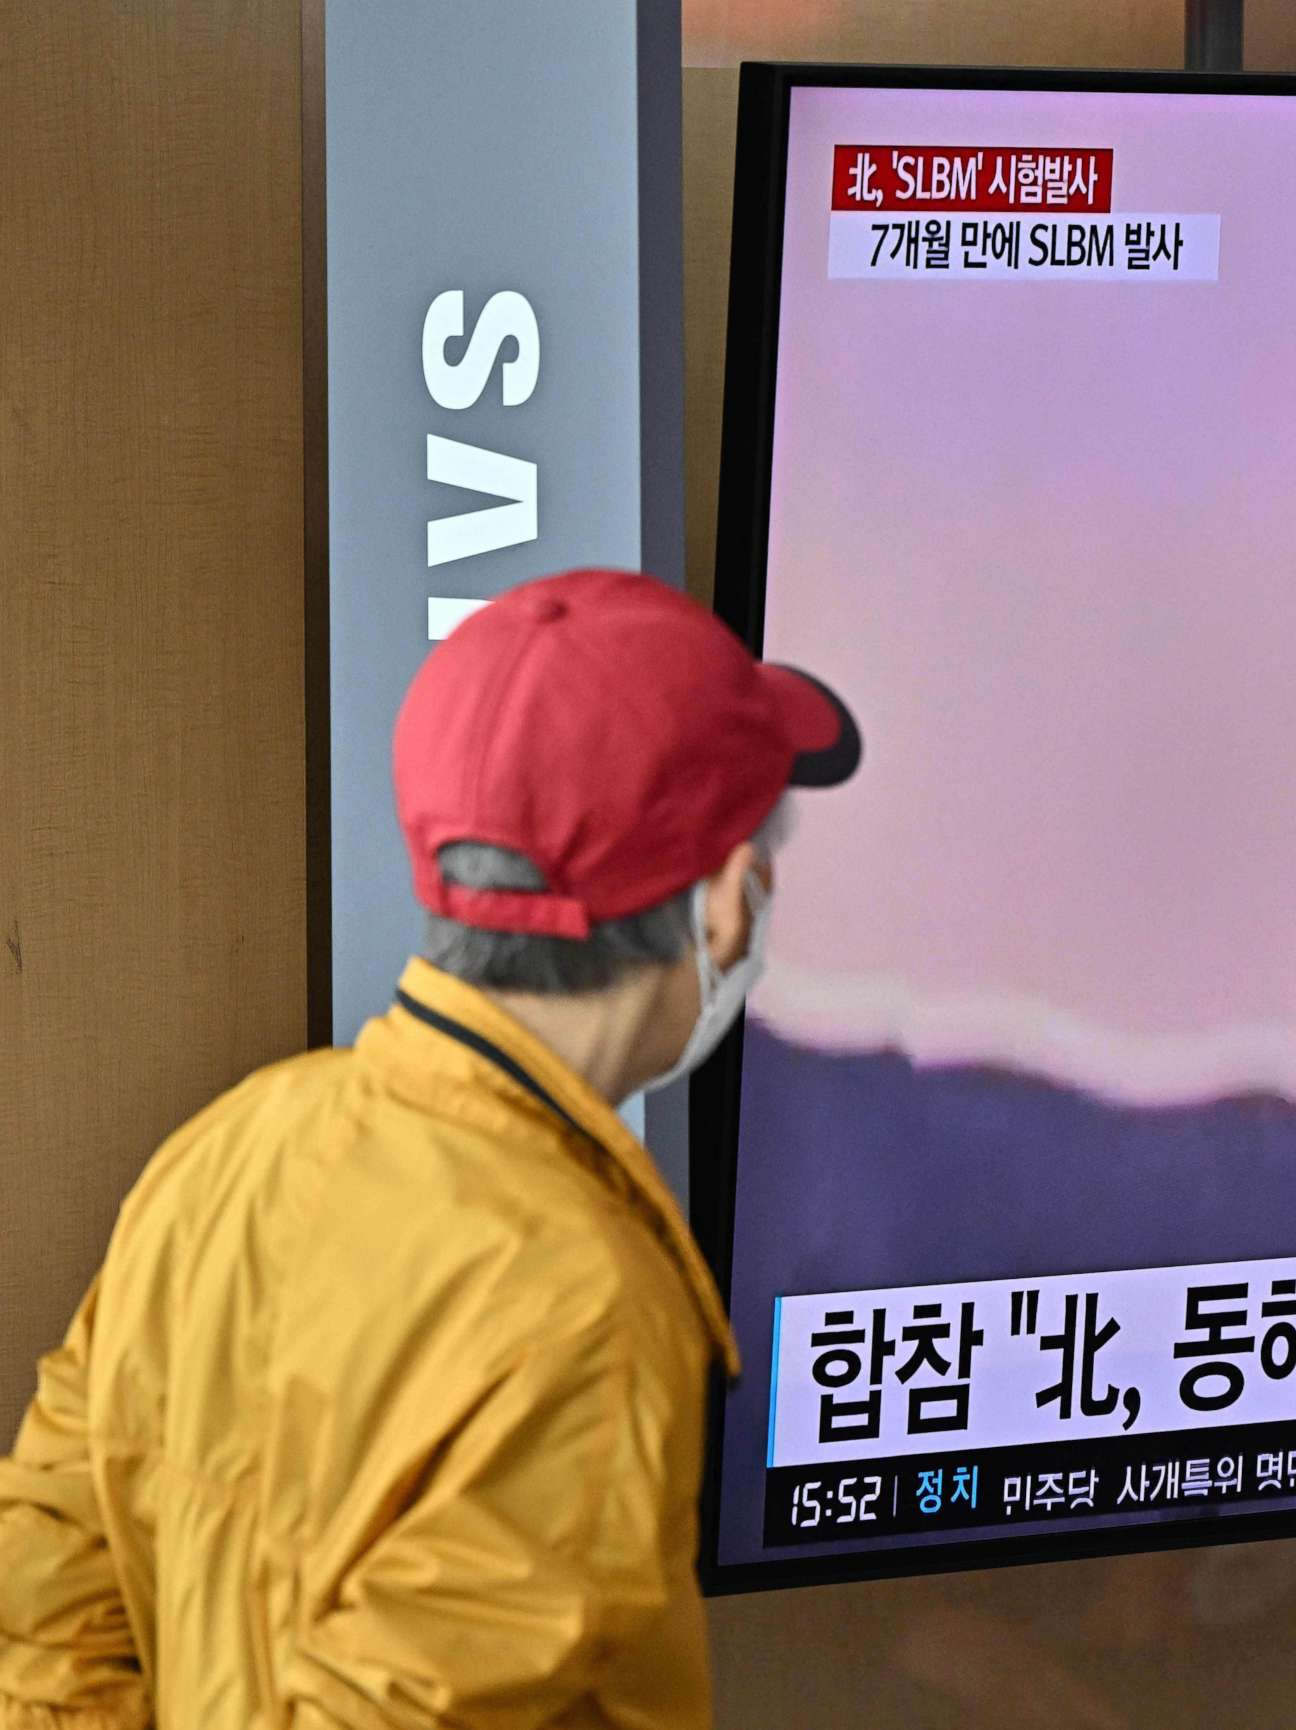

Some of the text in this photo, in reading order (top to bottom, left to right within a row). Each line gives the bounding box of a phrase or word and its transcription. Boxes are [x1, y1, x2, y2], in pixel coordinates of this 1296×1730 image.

[848, 151, 1098, 207] 北, 'SLBM' 시험발사
[870, 219, 1184, 270] 7개월 만에 SLBM 발사
[810, 1301, 984, 1444] 합참
[1009, 1288, 1141, 1431] "北,
[791, 1476, 882, 1527] 15:52
[916, 1465, 979, 1514] 정치
[1116, 1454, 1244, 1504] 사개특위
